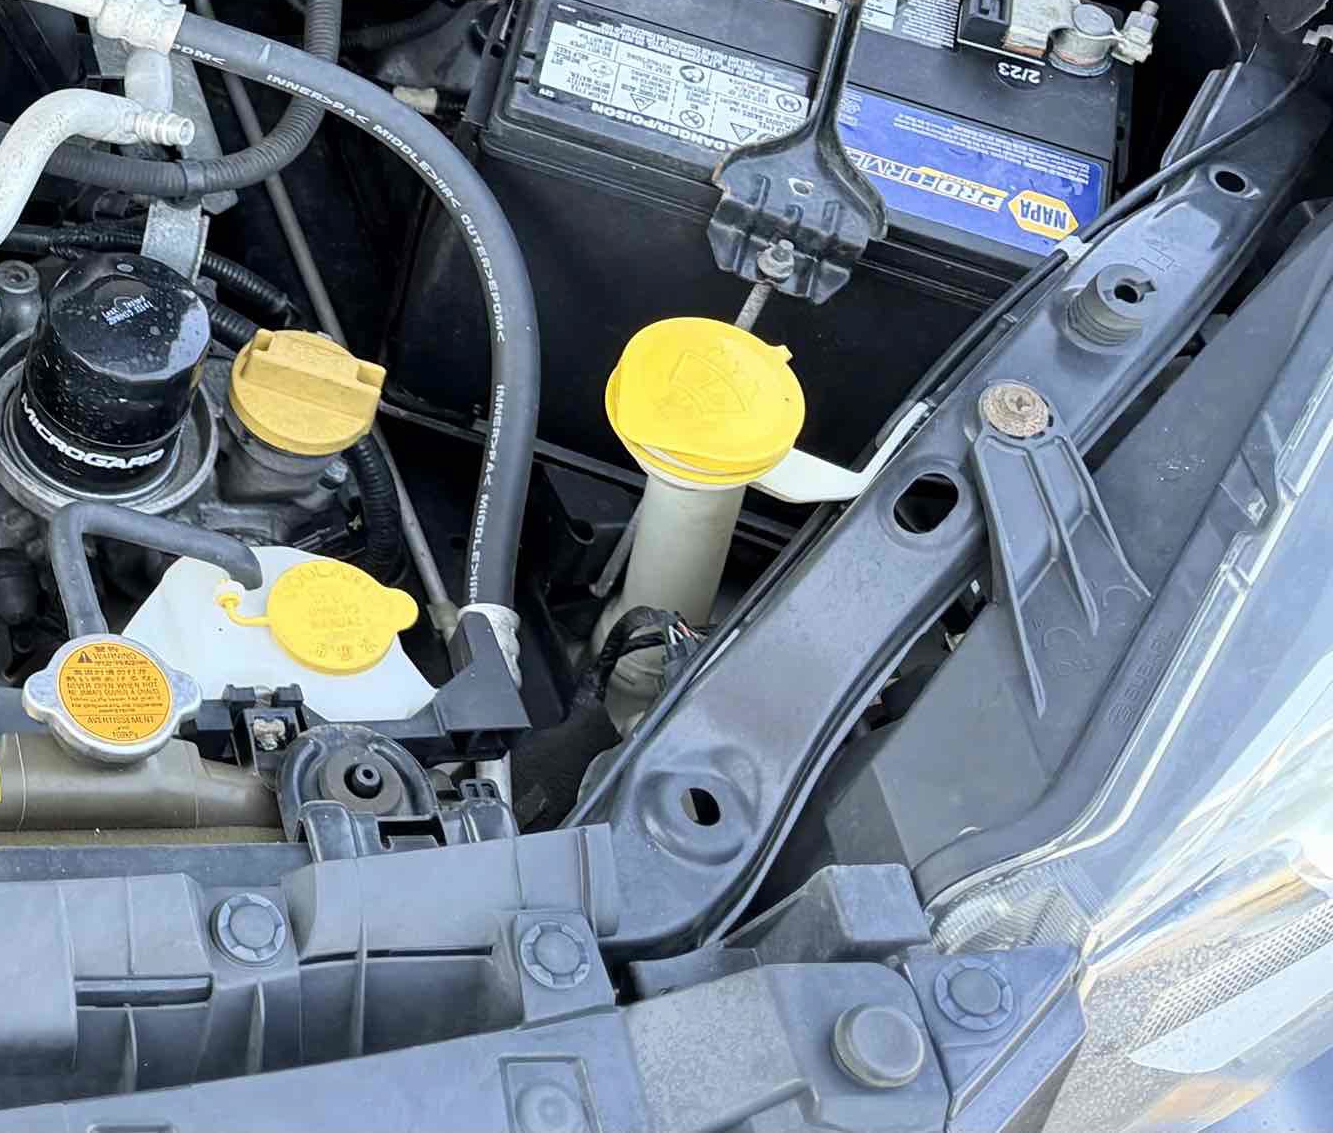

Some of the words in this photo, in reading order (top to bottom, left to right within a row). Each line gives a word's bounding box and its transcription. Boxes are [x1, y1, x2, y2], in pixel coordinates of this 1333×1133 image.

[998, 62, 1040, 83] 2/23
[591, 102, 727, 151] DANGER/POISON
[1020, 199, 1068, 230] NAPA
[21, 393, 165, 469] MICROGARD
